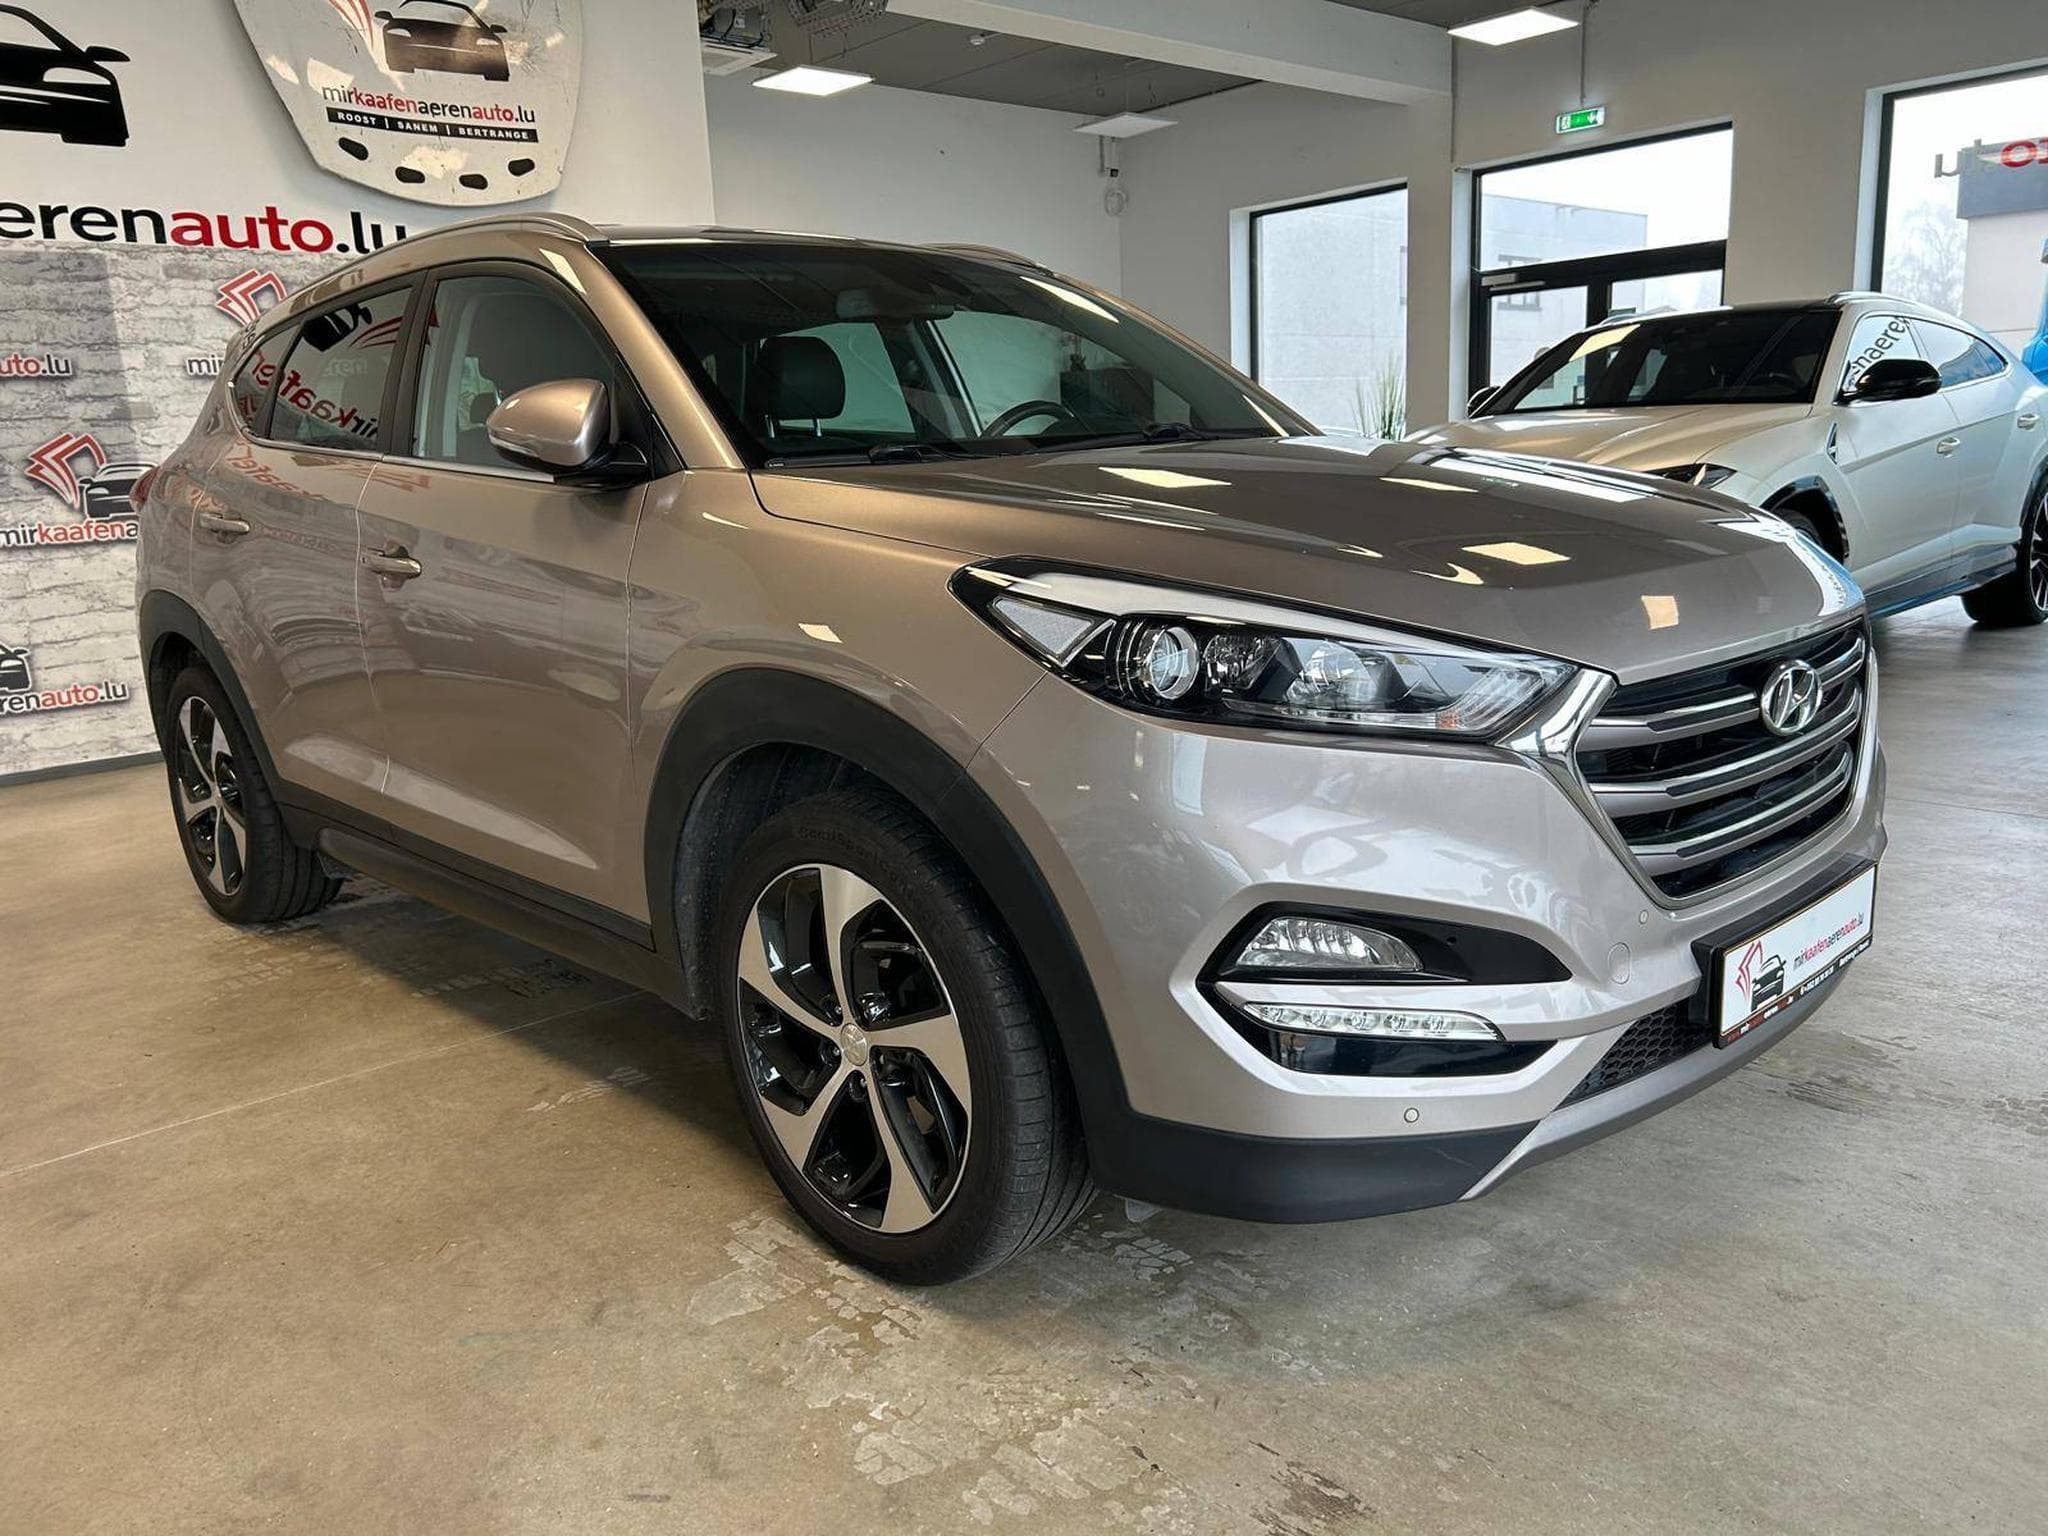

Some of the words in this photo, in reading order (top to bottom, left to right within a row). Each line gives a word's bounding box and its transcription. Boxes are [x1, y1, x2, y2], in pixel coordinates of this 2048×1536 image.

[322, 86, 536, 123] mirkaafenaerenauto.lu
[337, 111, 377, 126] ROOST
[397, 121, 438, 134] SANEM
[458, 127, 529, 140] BERTRANGE
